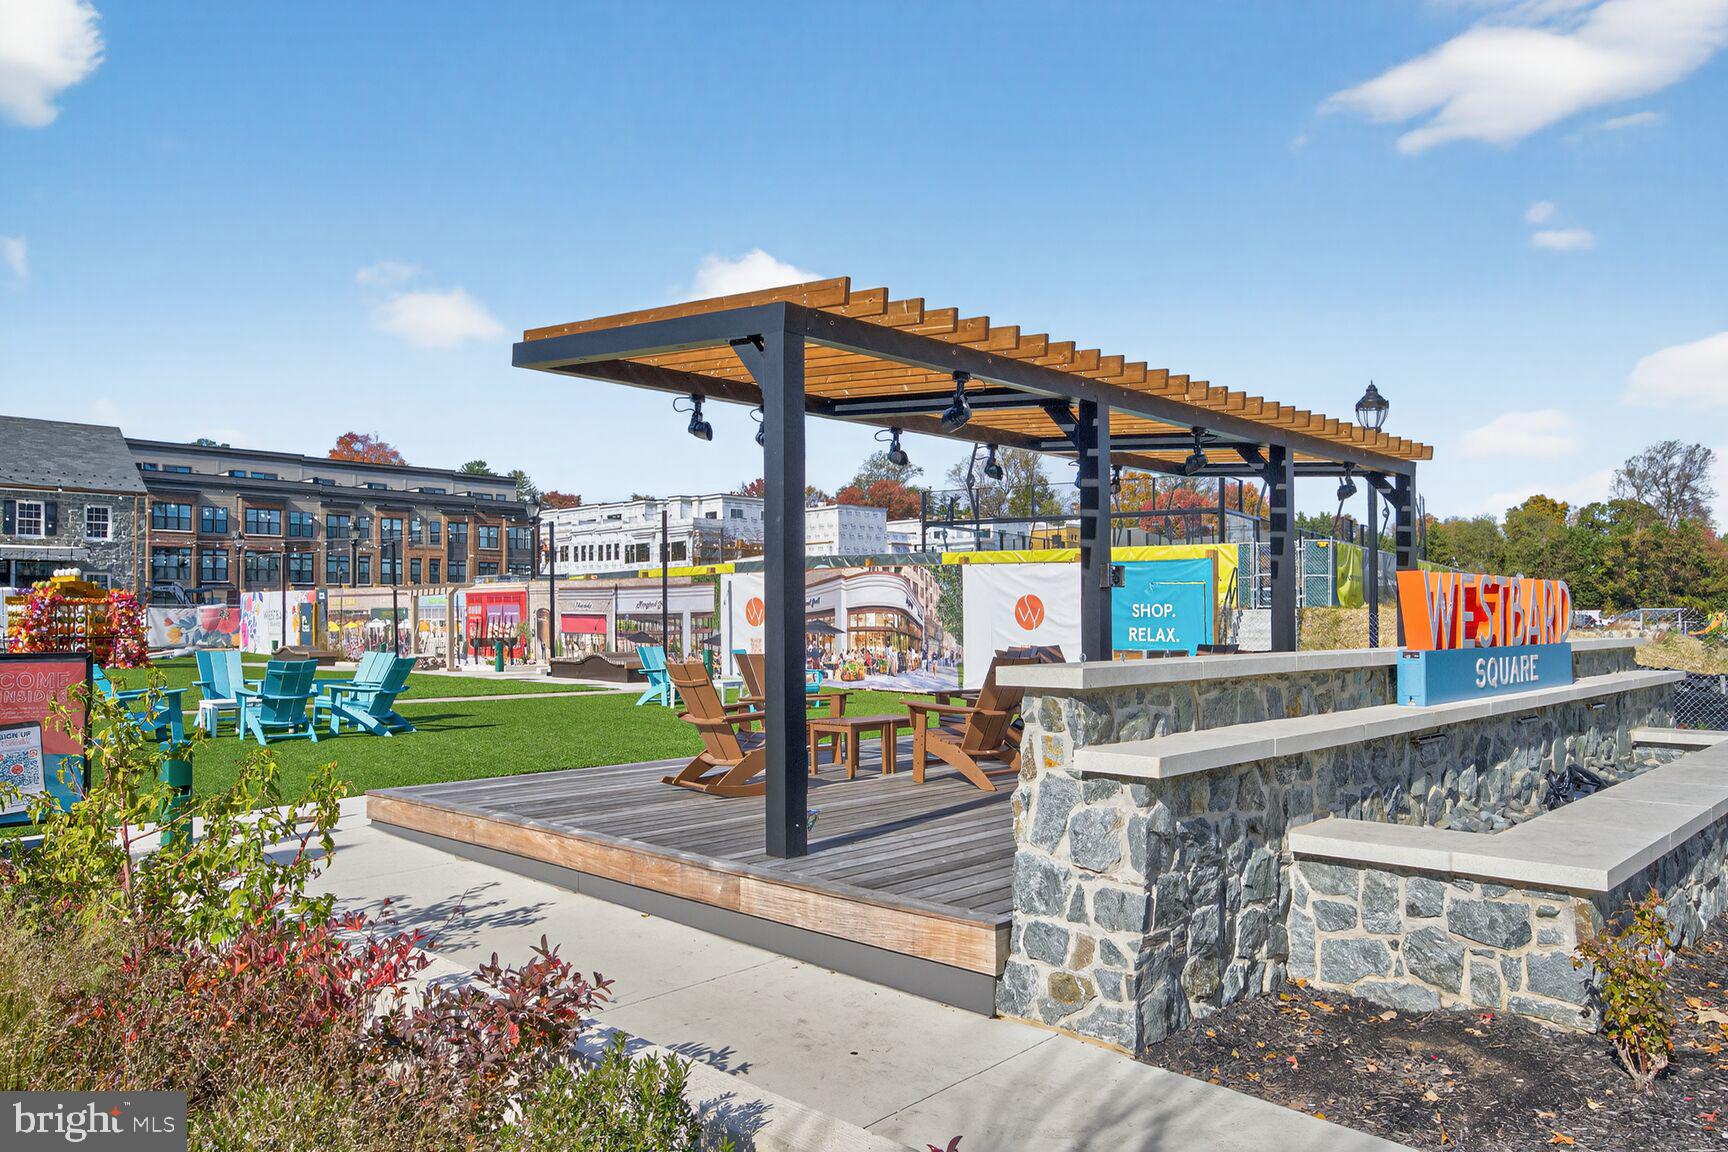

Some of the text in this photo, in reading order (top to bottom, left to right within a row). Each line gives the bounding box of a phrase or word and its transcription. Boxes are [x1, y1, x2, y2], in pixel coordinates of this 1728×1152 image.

[1132, 603, 1176, 618] SHOP.
[1422, 569, 1574, 651] WESTBARD
[1128, 627, 1180, 643] RELAX.
[1475, 654, 1539, 688] SQUARE
[20, 730, 31, 738] UP
